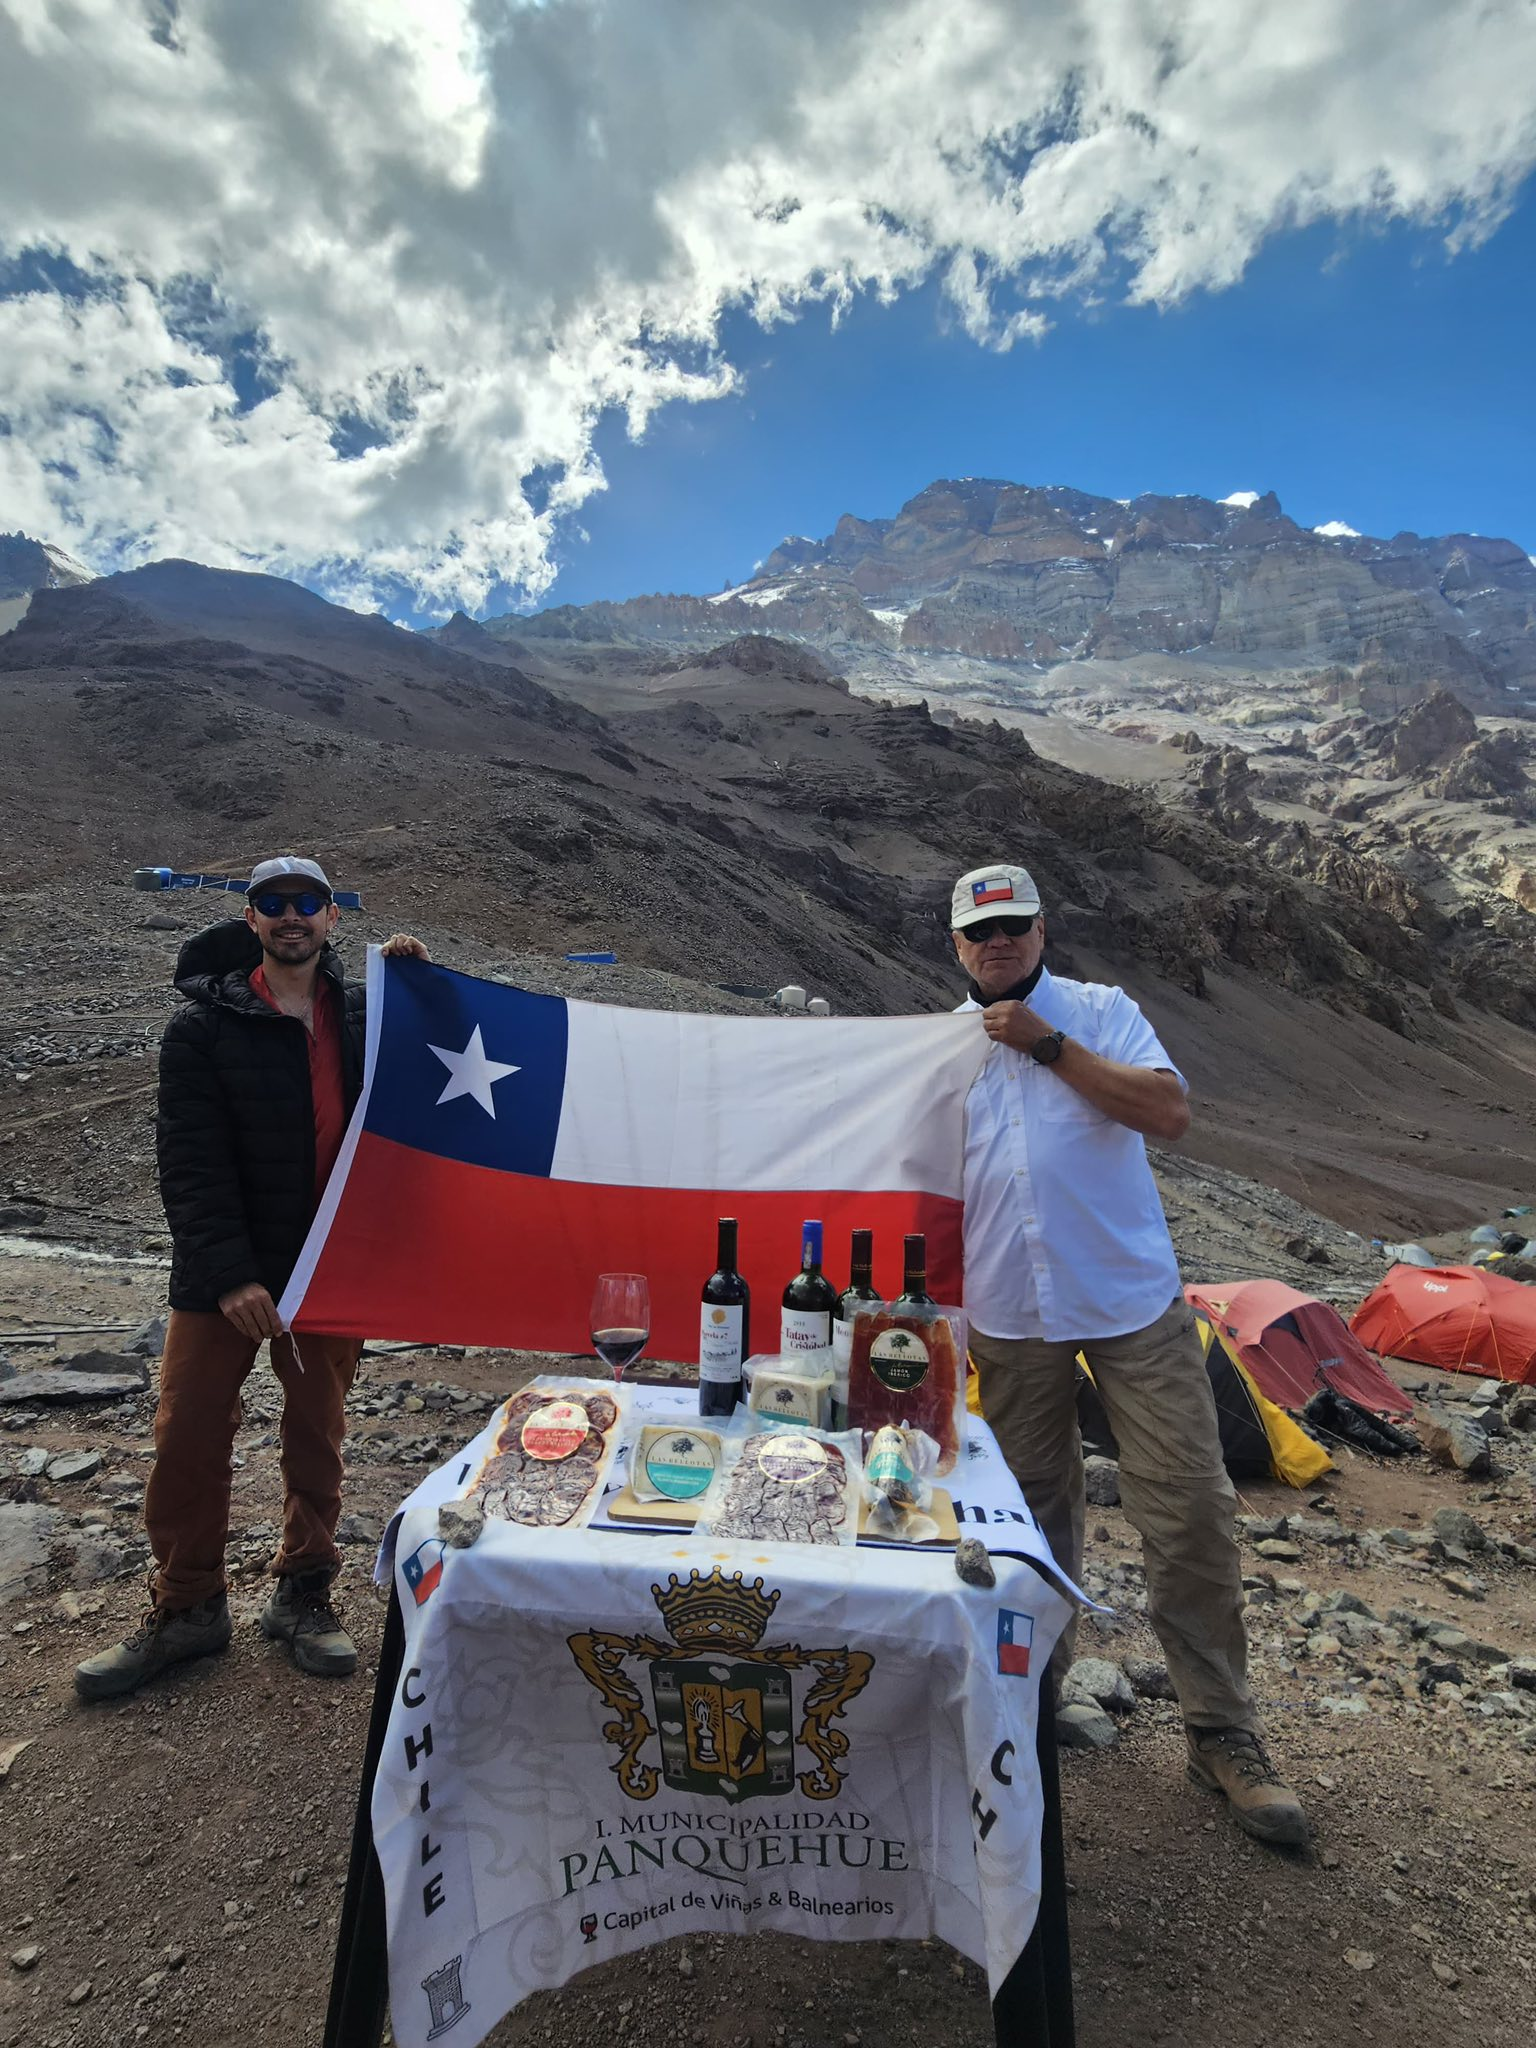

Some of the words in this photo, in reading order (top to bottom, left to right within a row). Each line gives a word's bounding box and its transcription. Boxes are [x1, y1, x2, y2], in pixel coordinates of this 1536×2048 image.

[785, 1327, 810, 1343] Tatay
[401, 1668, 446, 1918] CHILE
[972, 1739, 1016, 1857] CH
[620, 1811, 870, 1838] MUNICIPALIDAD
[558, 1833, 910, 1897] PANQUEHUE
[603, 1895, 677, 1931] Capital
[681, 1891, 706, 1909] de
[710, 1892, 763, 1915] Viñas
[768, 1891, 783, 1907] &
[788, 1890, 895, 1916] Balnearios
